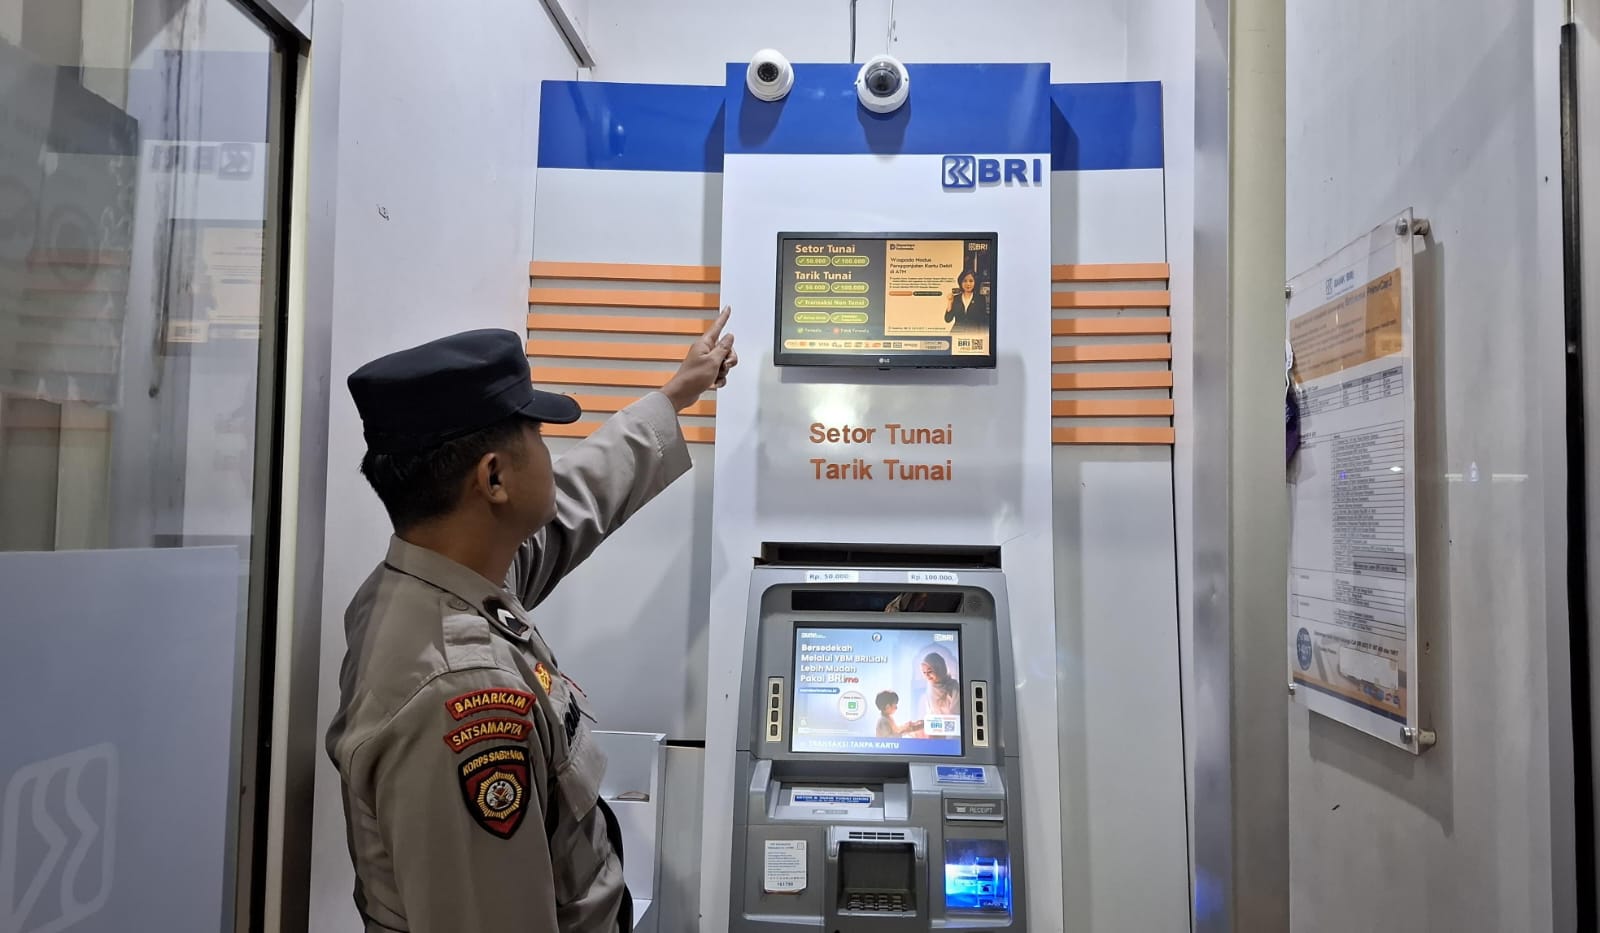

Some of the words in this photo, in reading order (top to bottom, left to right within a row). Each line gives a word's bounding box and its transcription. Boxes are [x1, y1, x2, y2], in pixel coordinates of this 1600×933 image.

[978, 158, 1043, 185] BRI
[795, 244, 824, 254] Setor
[827, 244, 856, 254] Tunai
[795, 271, 820, 281] Tarik
[823, 271, 852, 281] Tunai
[809, 422, 877, 444] Setor
[885, 422, 953, 445] Tunai
[810, 458, 874, 481] Tarik
[884, 458, 953, 481] Tunai
[801, 643, 854, 653] Bersedekah
[801, 654, 833, 663] Melalui
[800, 664, 824, 674] Lebih
[825, 665, 857, 674] Mudah
[800, 674, 826, 684] Pakai
[454, 691, 527, 713] BAHARKAM
[452, 720, 523, 747] SATSAMAPTA
[463, 754, 489, 776] KORPS
[969, 806, 993, 814] RECEIPT
